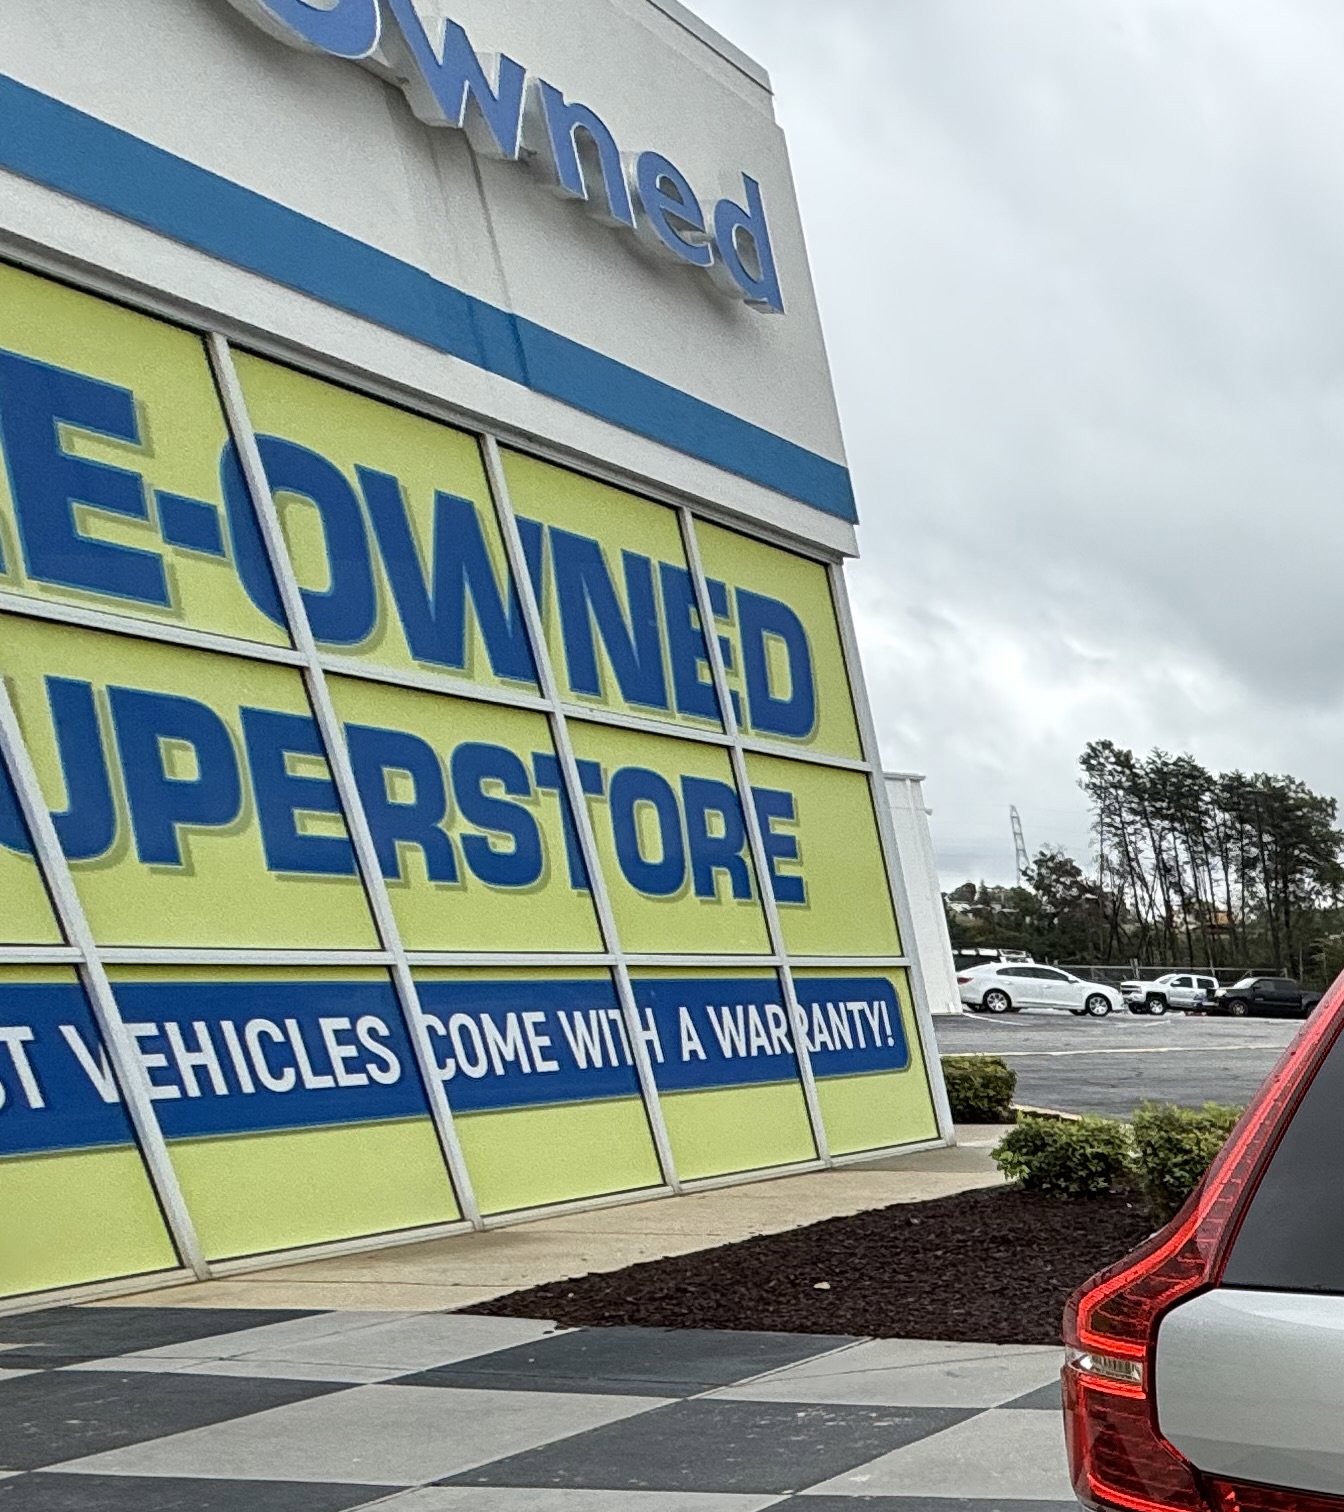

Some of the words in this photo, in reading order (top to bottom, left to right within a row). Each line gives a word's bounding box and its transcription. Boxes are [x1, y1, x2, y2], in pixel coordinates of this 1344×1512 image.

[0, 347, 818, 740] E-OWNED
[421, 1011, 559, 1081] COME
[679, 1005, 707, 1062] A
[707, 1001, 895, 1060] WARRANTY!
